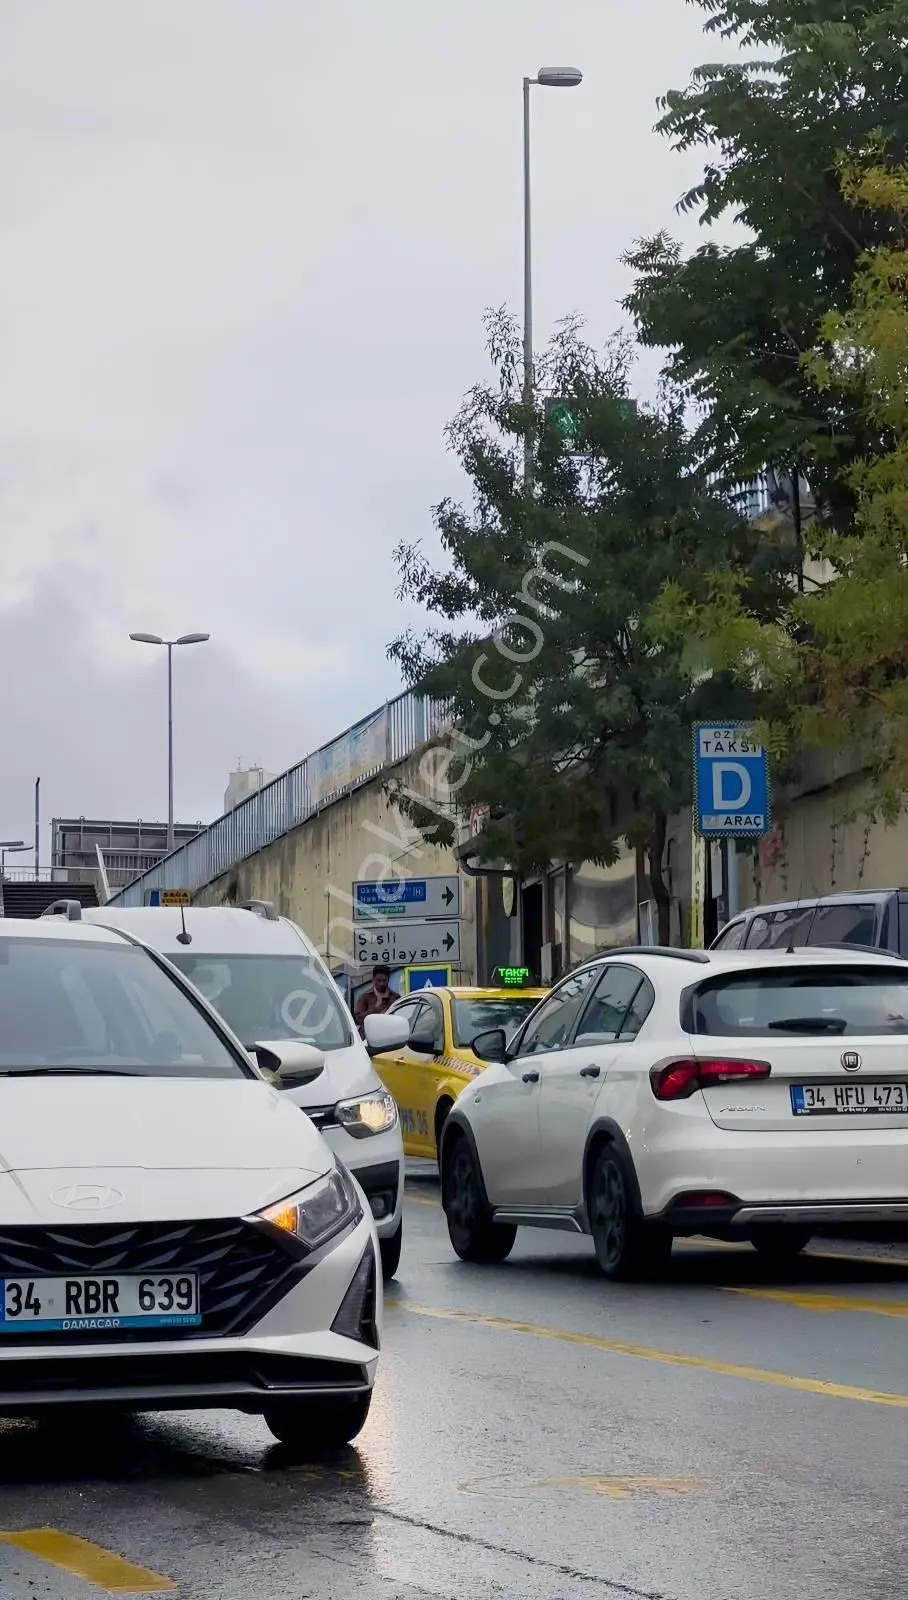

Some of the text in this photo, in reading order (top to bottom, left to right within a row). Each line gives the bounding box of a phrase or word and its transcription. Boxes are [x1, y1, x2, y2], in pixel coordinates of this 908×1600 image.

[712, 762, 752, 810] D
[723, 815, 762, 828] ARAÇ
[805, 1086, 904, 1107] 34 HFU 473
[6, 1277, 193, 1317] 34 RBR 639
[62, 1318, 121, 1330] DAMACAR
